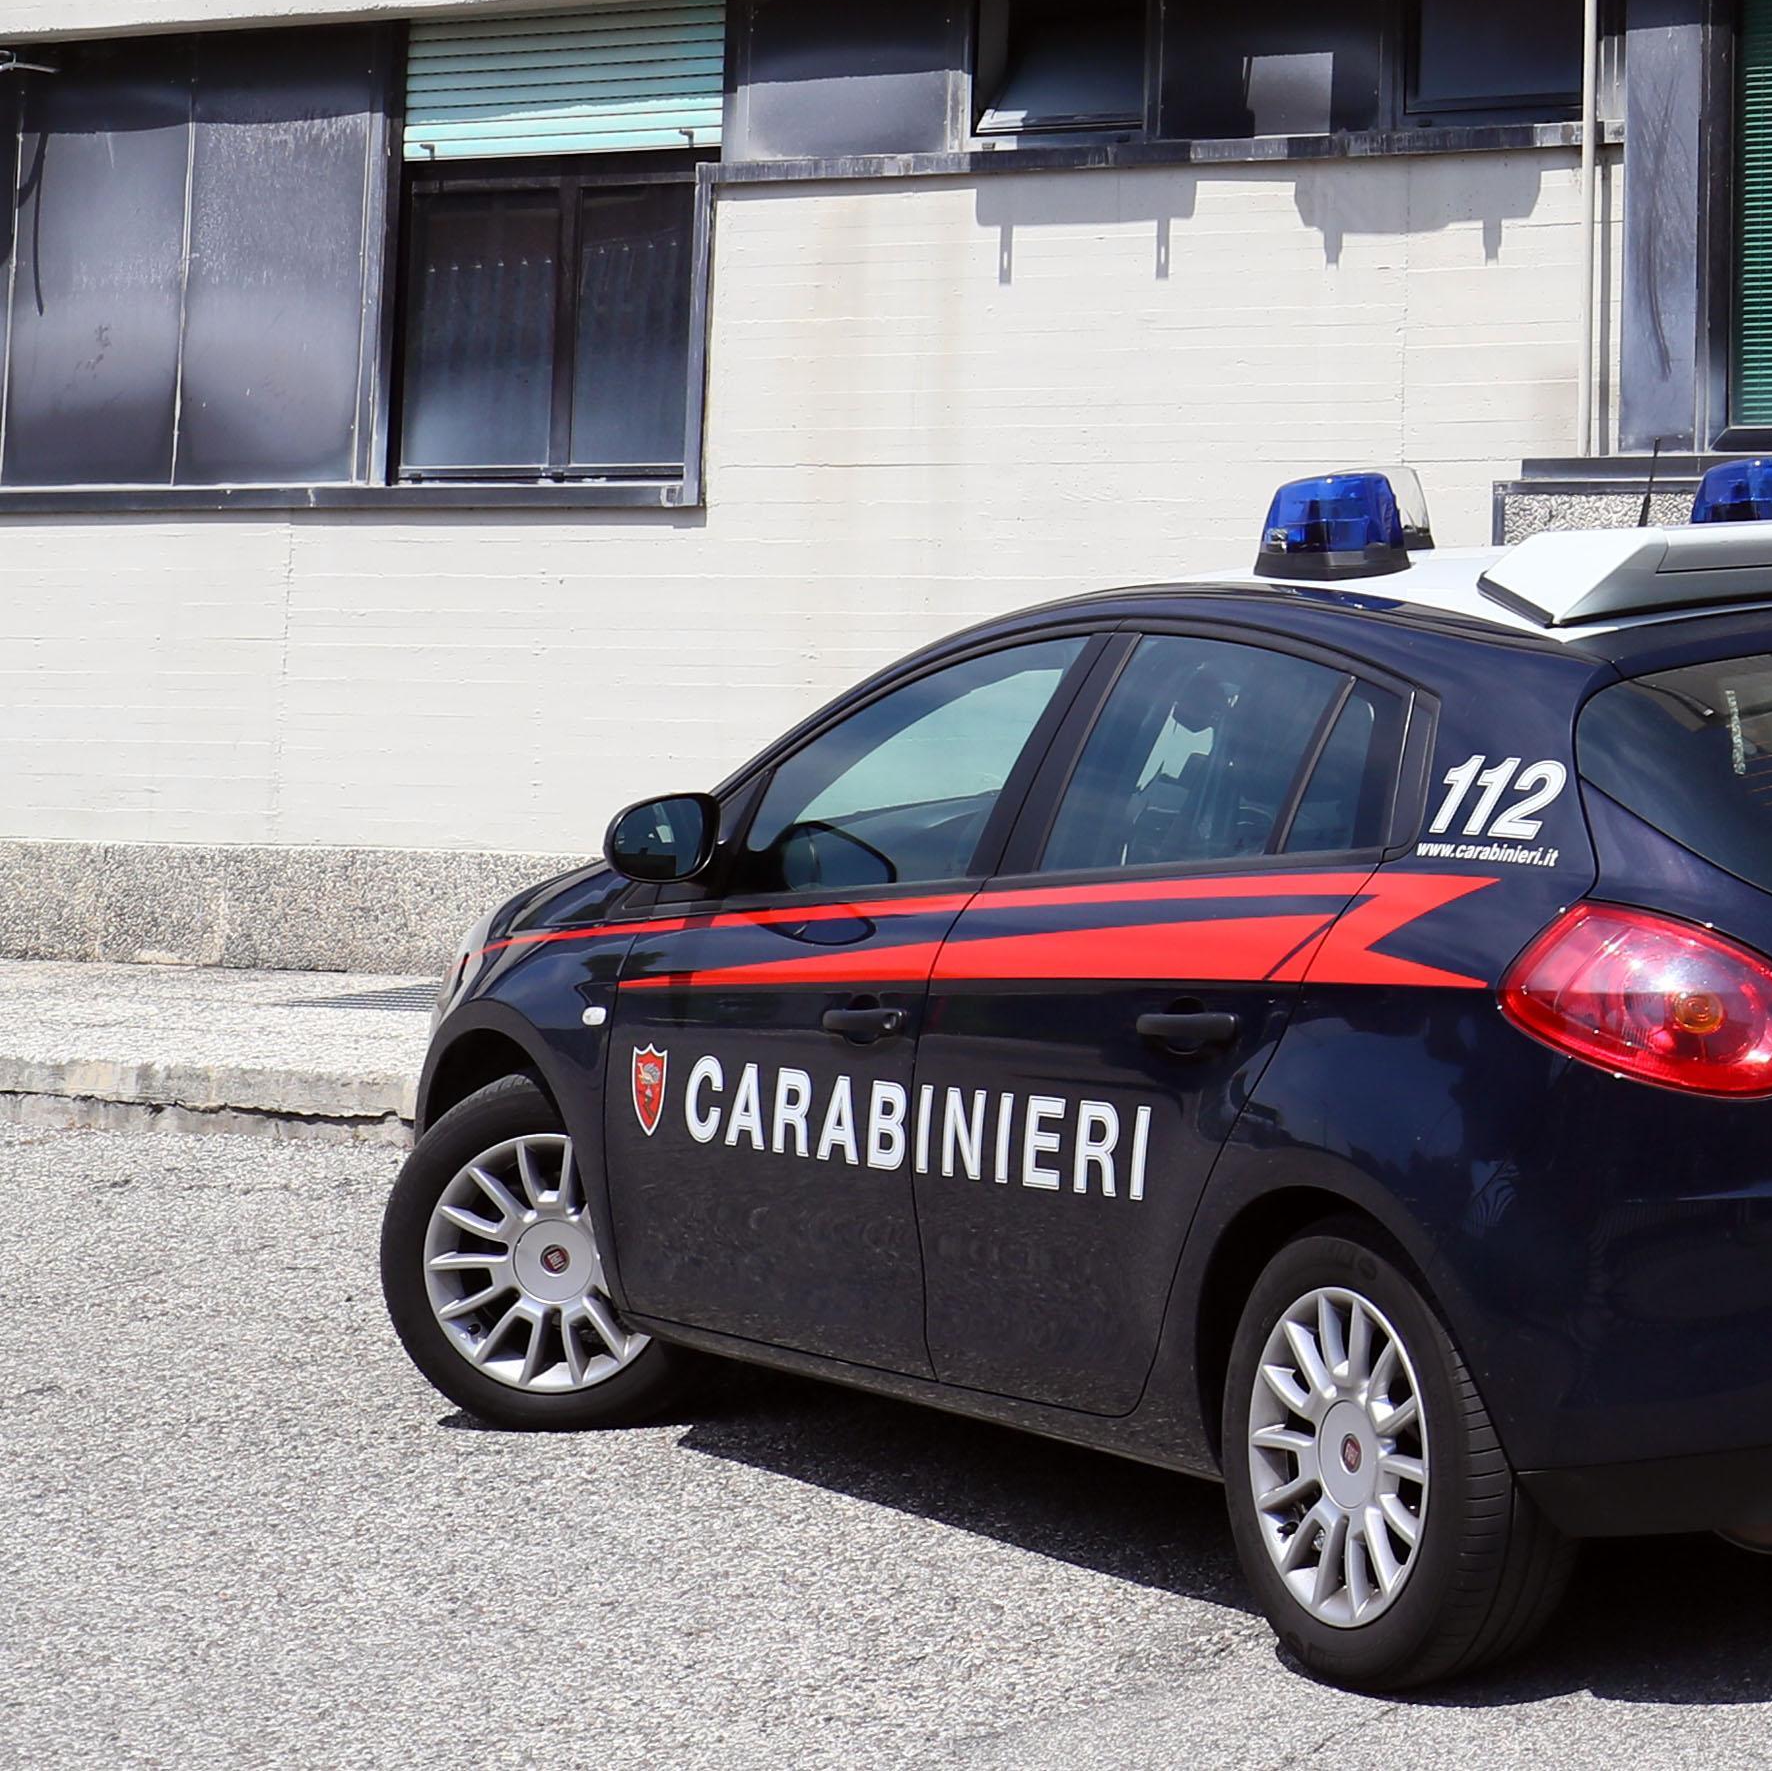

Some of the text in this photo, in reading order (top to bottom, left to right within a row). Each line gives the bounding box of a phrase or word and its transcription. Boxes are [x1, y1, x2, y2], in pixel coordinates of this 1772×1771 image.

[1429, 755, 1567, 840] 112
[1416, 843, 1560, 867] www.carabinieri.it
[684, 1055, 1152, 1202] CARABINIERI
